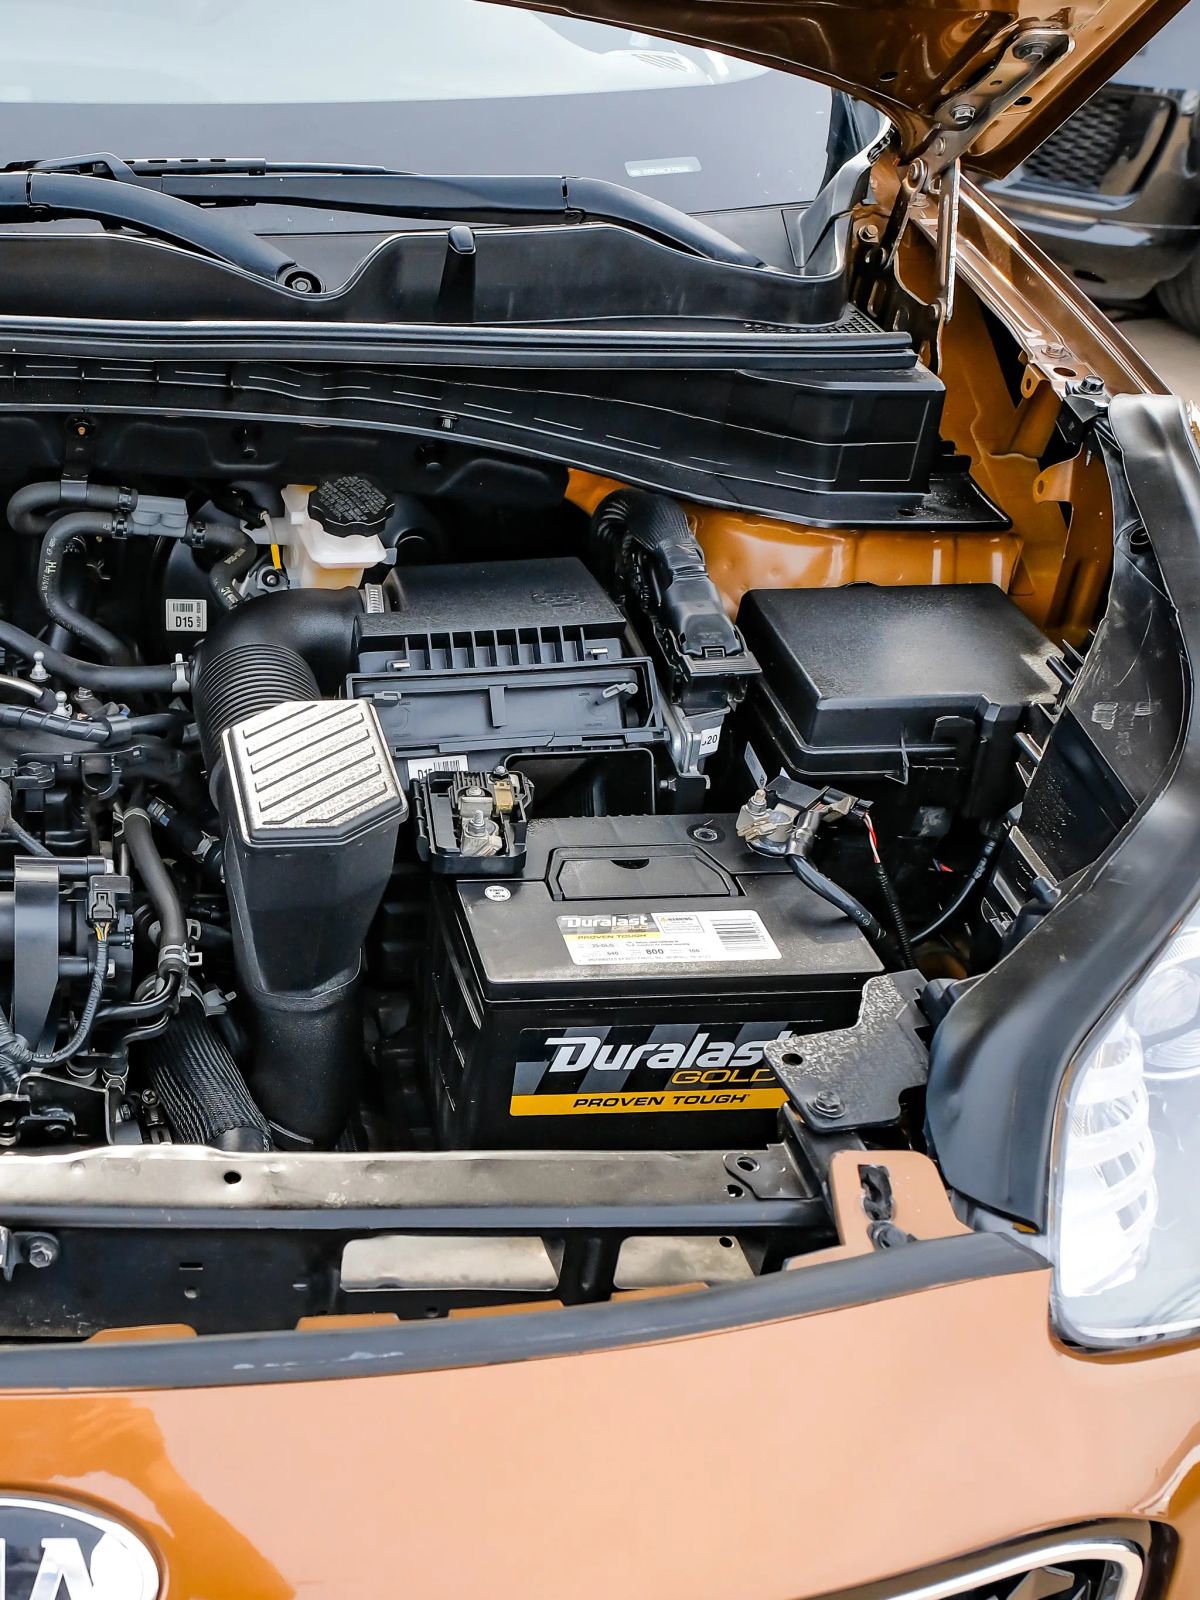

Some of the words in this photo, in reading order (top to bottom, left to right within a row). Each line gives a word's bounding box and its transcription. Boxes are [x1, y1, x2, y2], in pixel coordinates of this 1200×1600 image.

[175, 616, 194, 628] D15
[561, 915, 648, 928] Duralast
[544, 1030, 793, 1073] Duralas
[671, 1068, 777, 1085] GOLD
[573, 1097, 664, 1108] PROVEN
[673, 1094, 750, 1105] TOUGH
